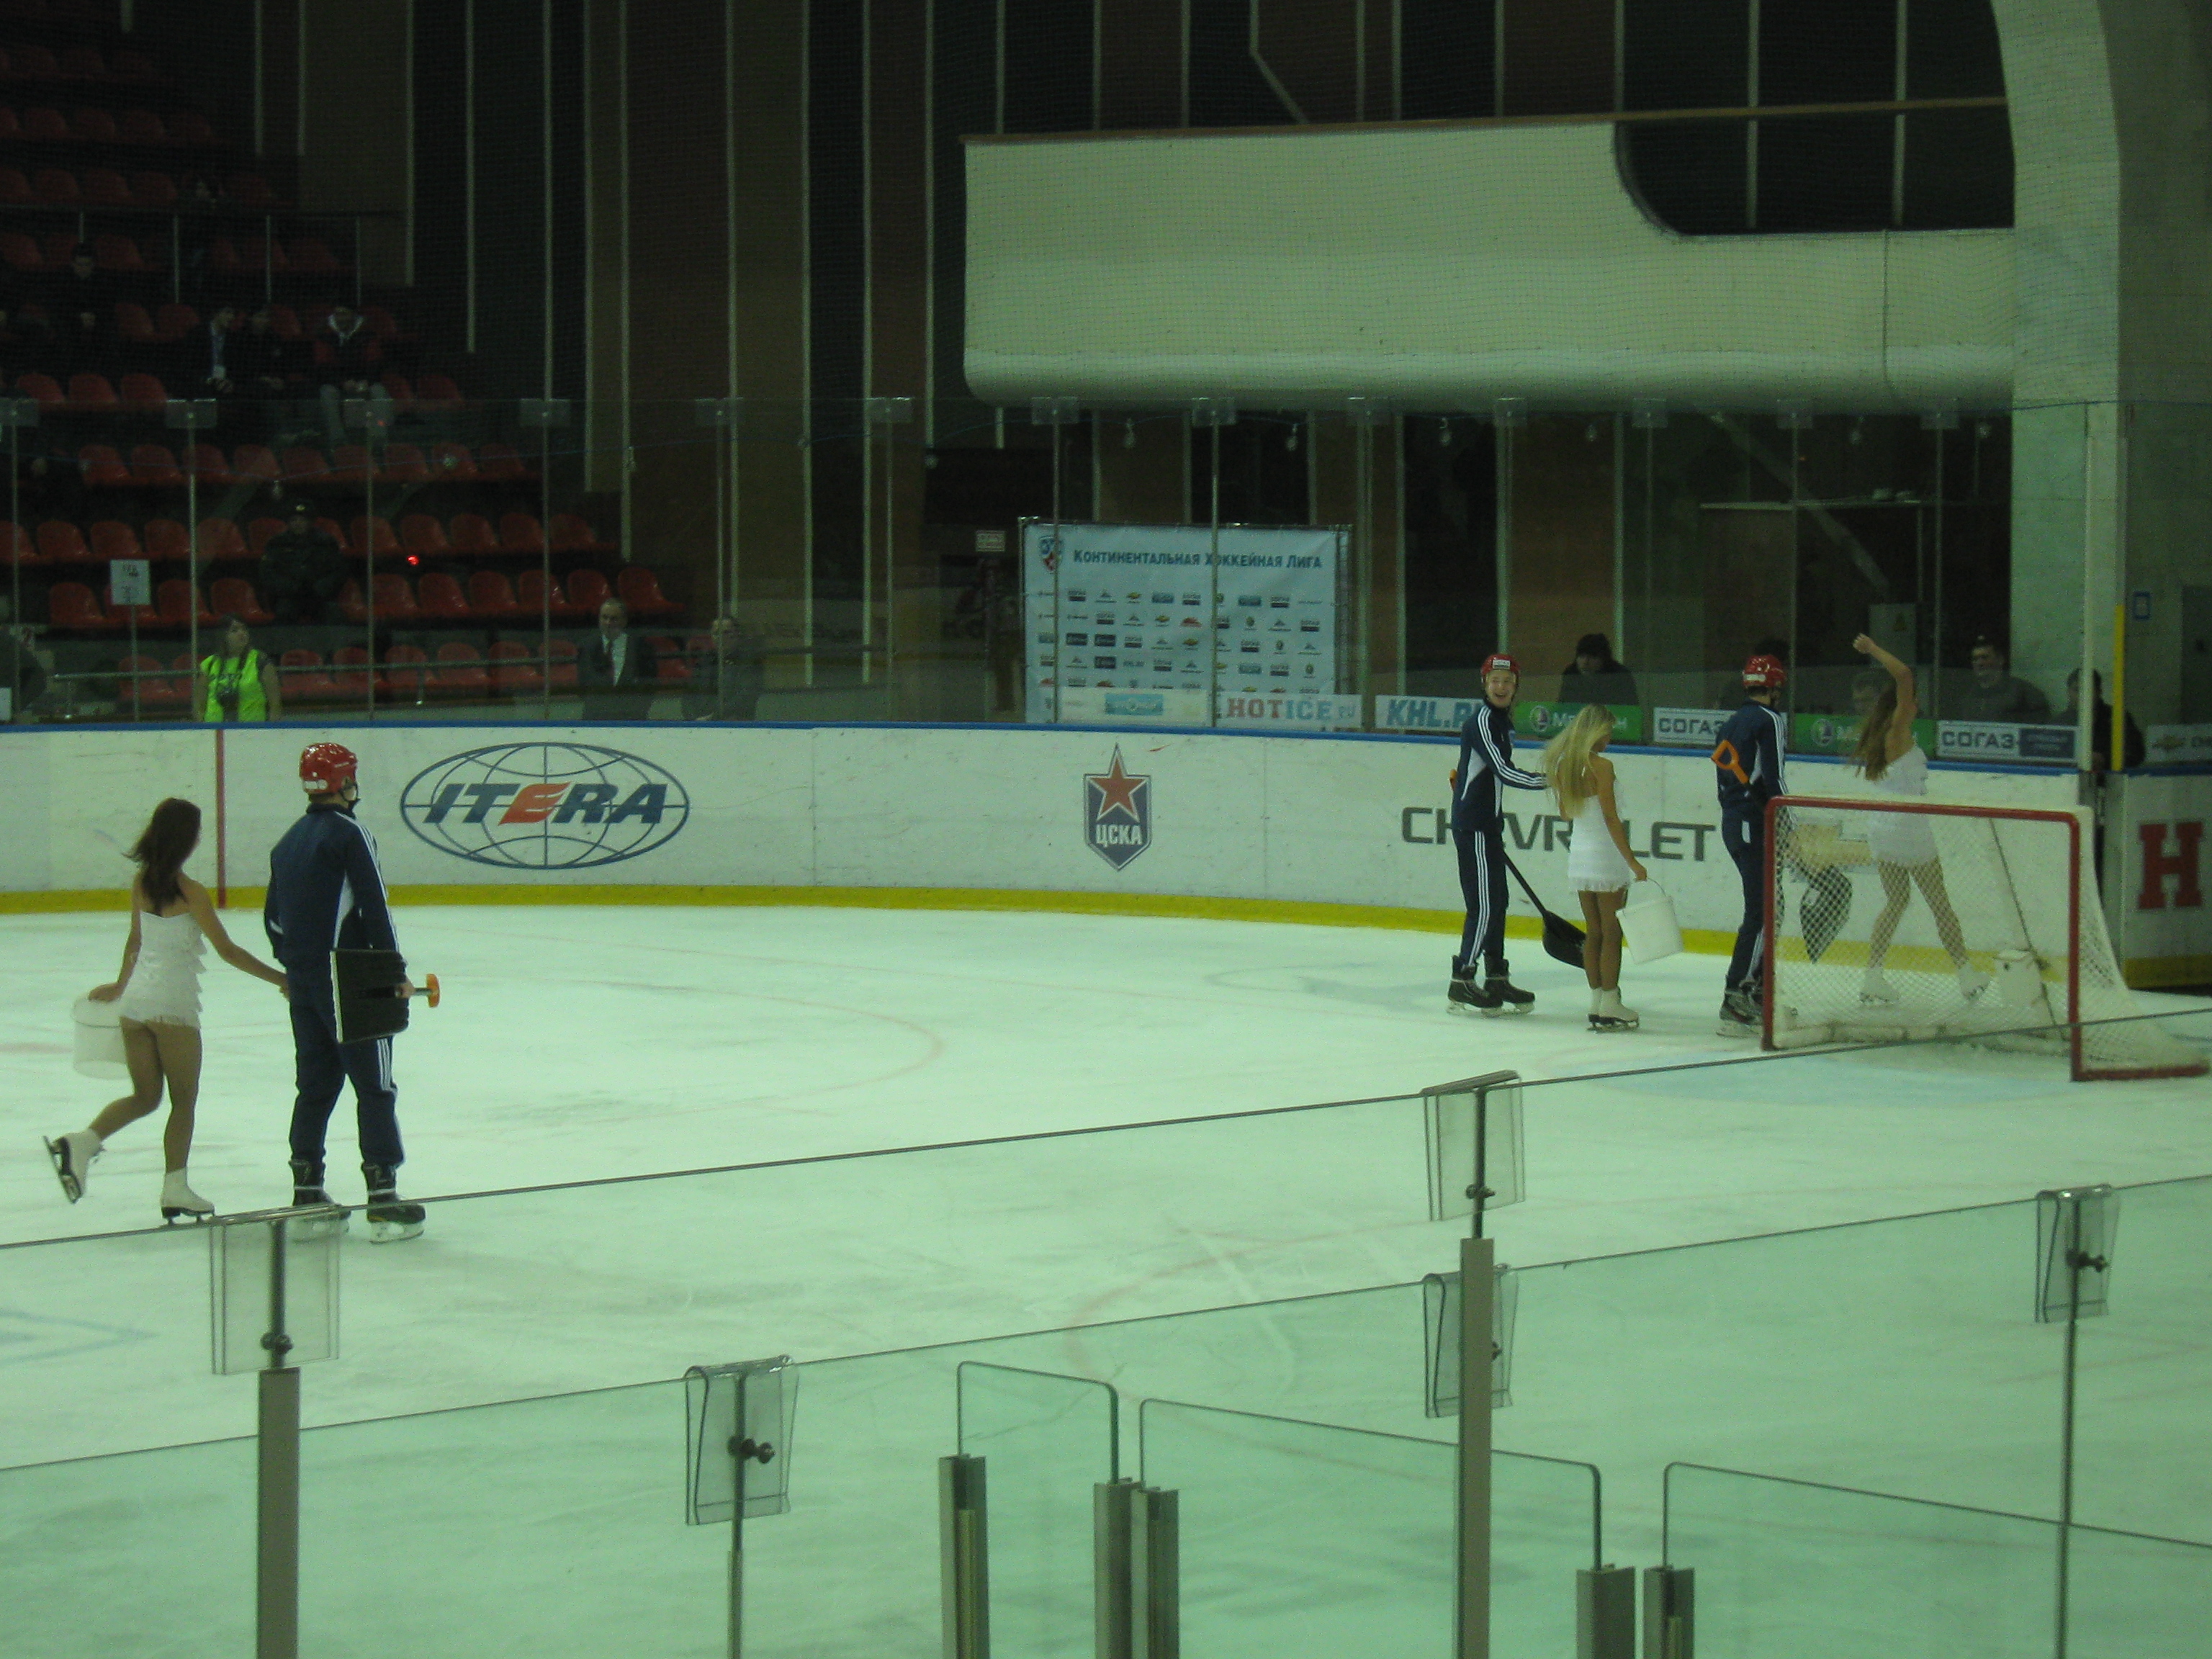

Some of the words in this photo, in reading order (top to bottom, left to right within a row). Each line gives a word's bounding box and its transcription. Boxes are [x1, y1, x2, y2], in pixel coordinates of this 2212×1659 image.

[1226, 698, 1332, 720] HOTICE
[1386, 698, 1483, 728] KHL.R
[1941, 731, 2017, 750] СОГАЗ
[423, 781, 668, 826] ITERA
[1095, 824, 1142, 848] ЦСКА
[1401, 806, 1717, 862] CHVRLET
